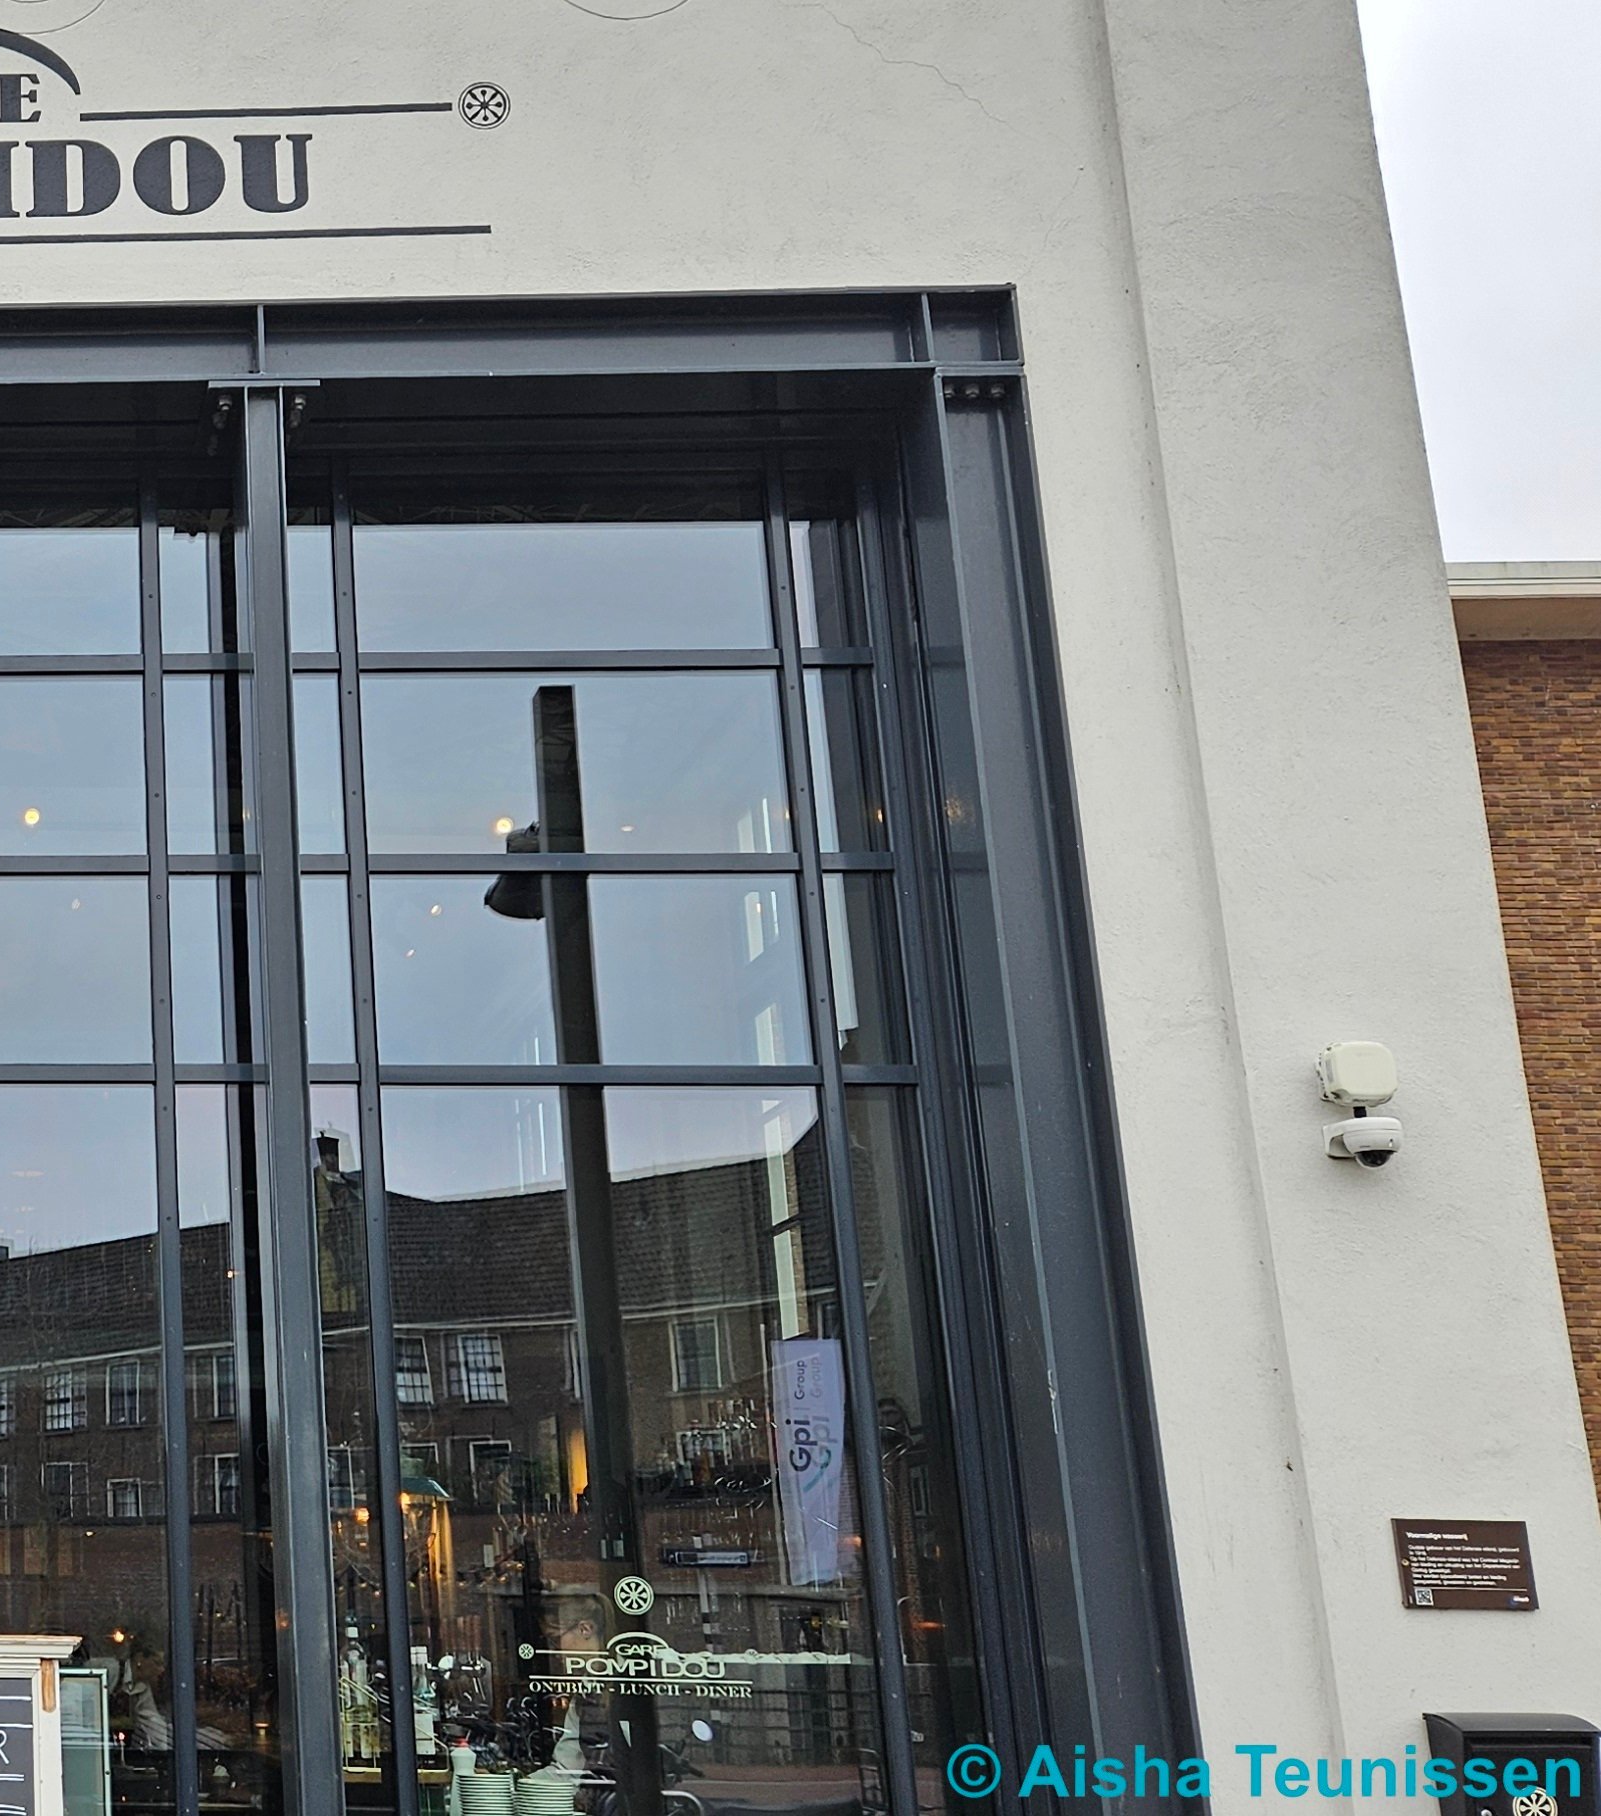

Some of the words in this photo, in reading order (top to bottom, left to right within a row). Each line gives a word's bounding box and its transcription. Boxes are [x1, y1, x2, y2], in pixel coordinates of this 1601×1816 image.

[794, 1360, 807, 1400] Group
[785, 1418, 818, 1472] Gpi
[565, 1657, 726, 1679] POMPIDOU
[529, 1681, 605, 1695] ONTBIJT
[619, 1683, 681, 1697] LUNCH
[695, 1684, 753, 1699] DINER
